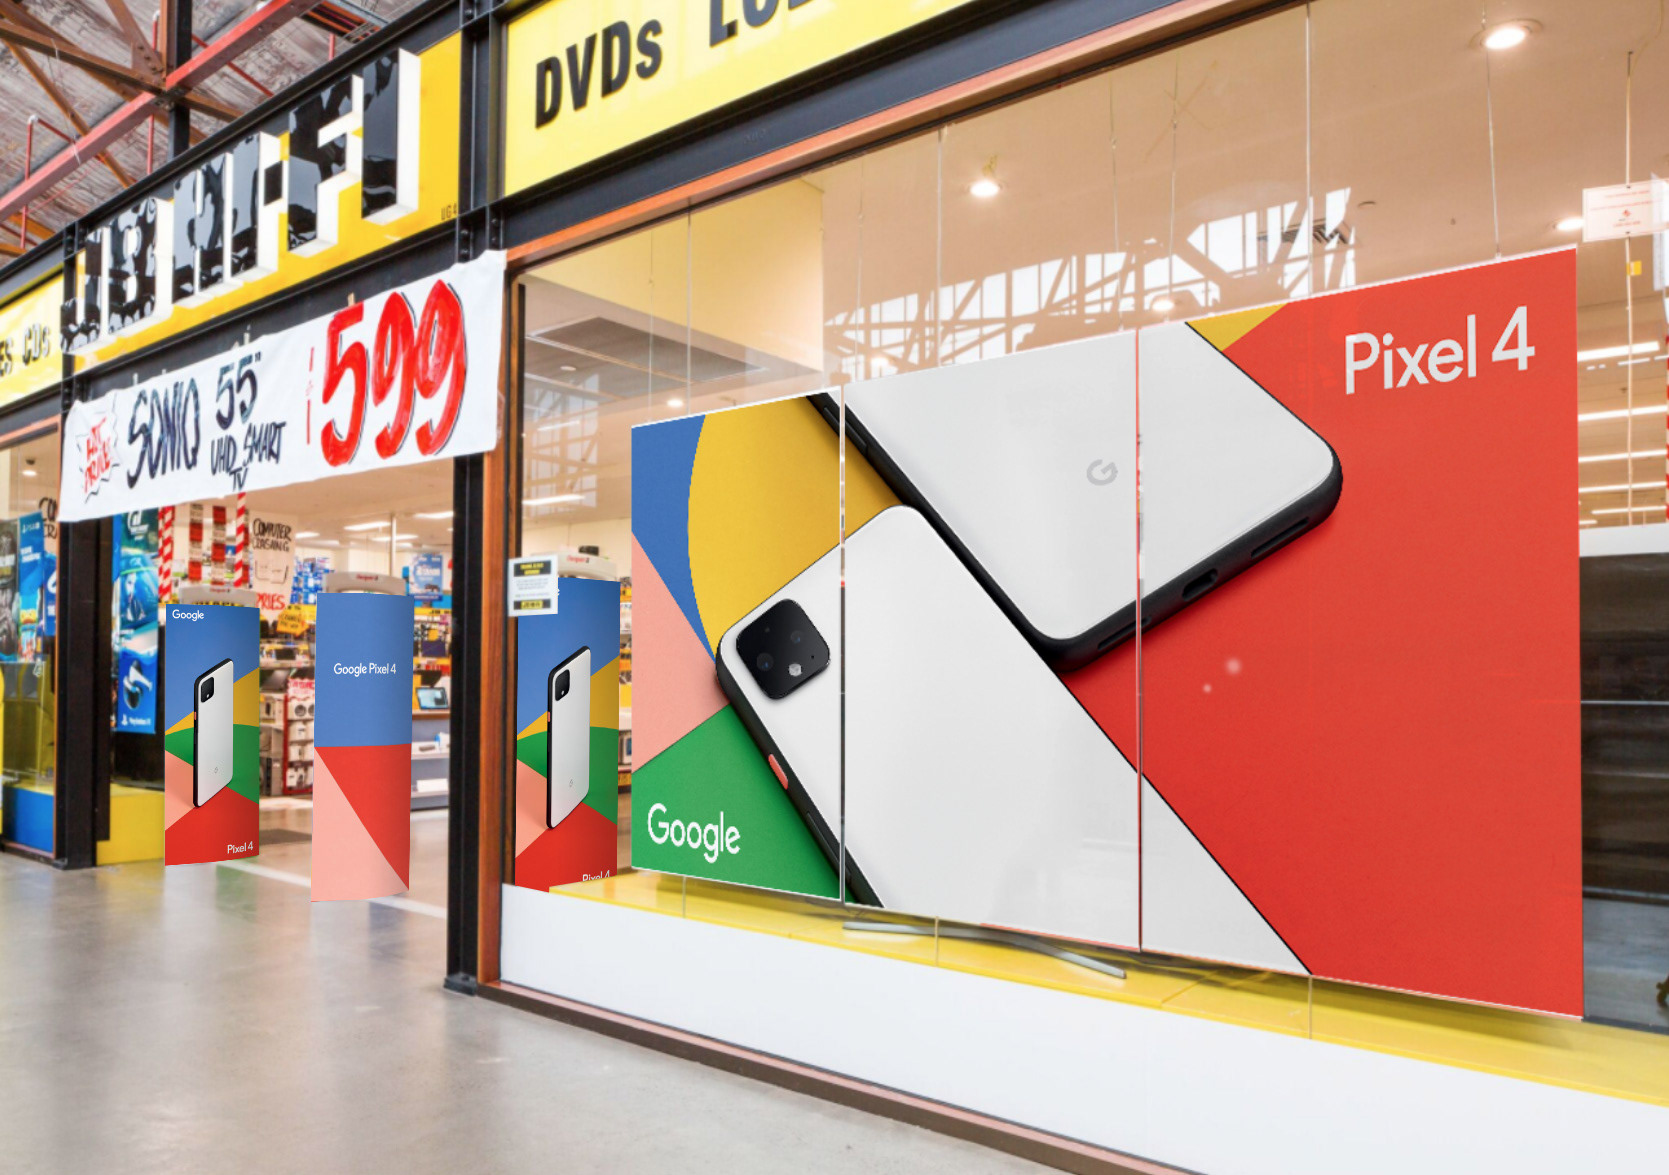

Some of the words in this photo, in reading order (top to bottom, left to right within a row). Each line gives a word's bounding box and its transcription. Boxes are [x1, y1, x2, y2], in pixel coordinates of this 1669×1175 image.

[534, 18, 663, 129] DVDs
[60, 197, 174, 355] JB
[172, 48, 414, 308] HI-FI
[320, 278, 468, 468] 599
[1345, 313, 1477, 395] Pixel
[1491, 305, 1536, 371] 4
[210, 436, 239, 476] UHD
[242, 420, 287, 467] SMART
[230, 466, 249, 492] TV
[171, 609, 205, 622] Google
[333, 662, 367, 678] Google
[368, 662, 389, 675] Pixel
[390, 663, 397, 675] 4
[227, 841, 247, 854] Pixel
[247, 840, 254, 851] 4
[647, 802, 741, 864] Google
